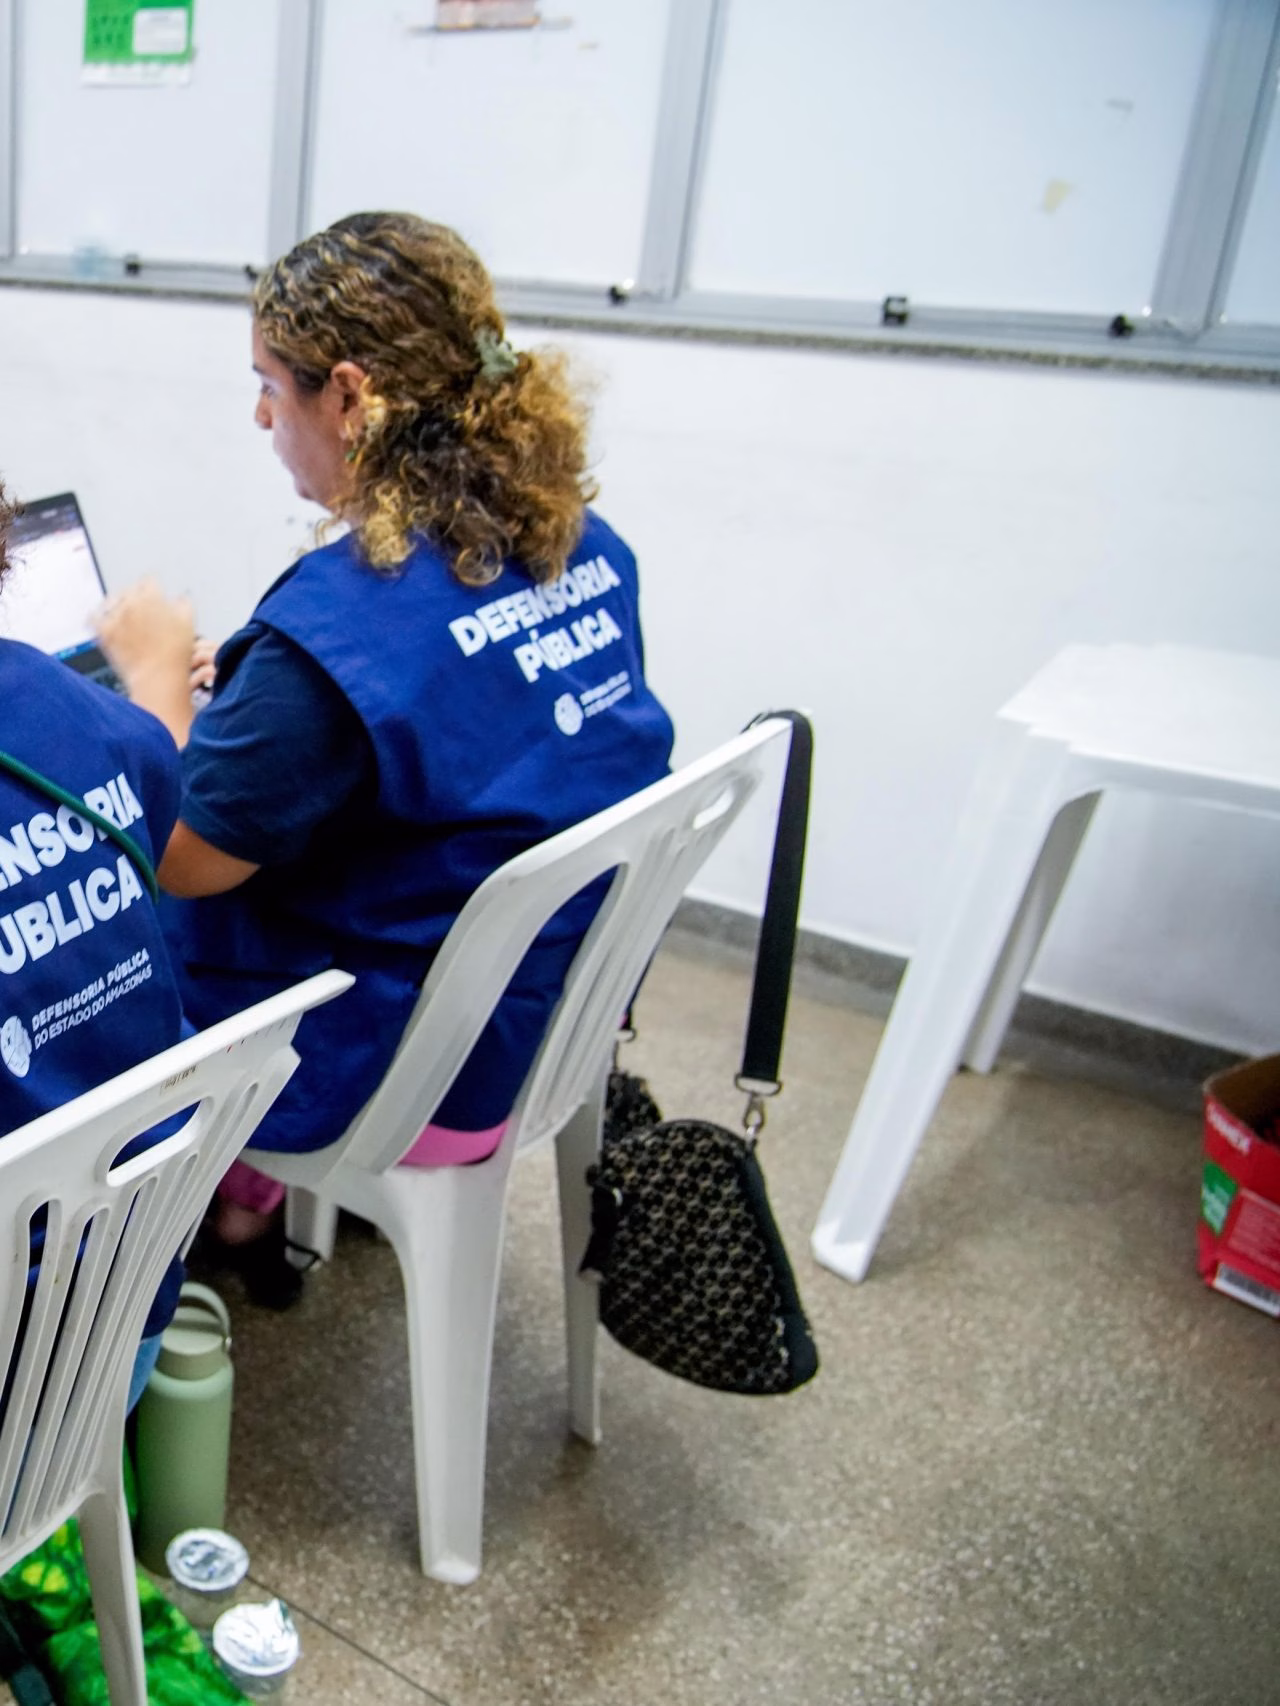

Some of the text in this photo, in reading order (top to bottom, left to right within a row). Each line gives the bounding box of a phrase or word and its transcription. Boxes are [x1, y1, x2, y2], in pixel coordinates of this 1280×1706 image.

[448, 555, 621, 657] DEFENSORIA
[513, 608, 623, 683] PÚBLICA
[31, 947, 150, 1032] DEFENSORIA PÚBLICA
[34, 964, 153, 1050] DO ESTADO DO AMAZONAS
